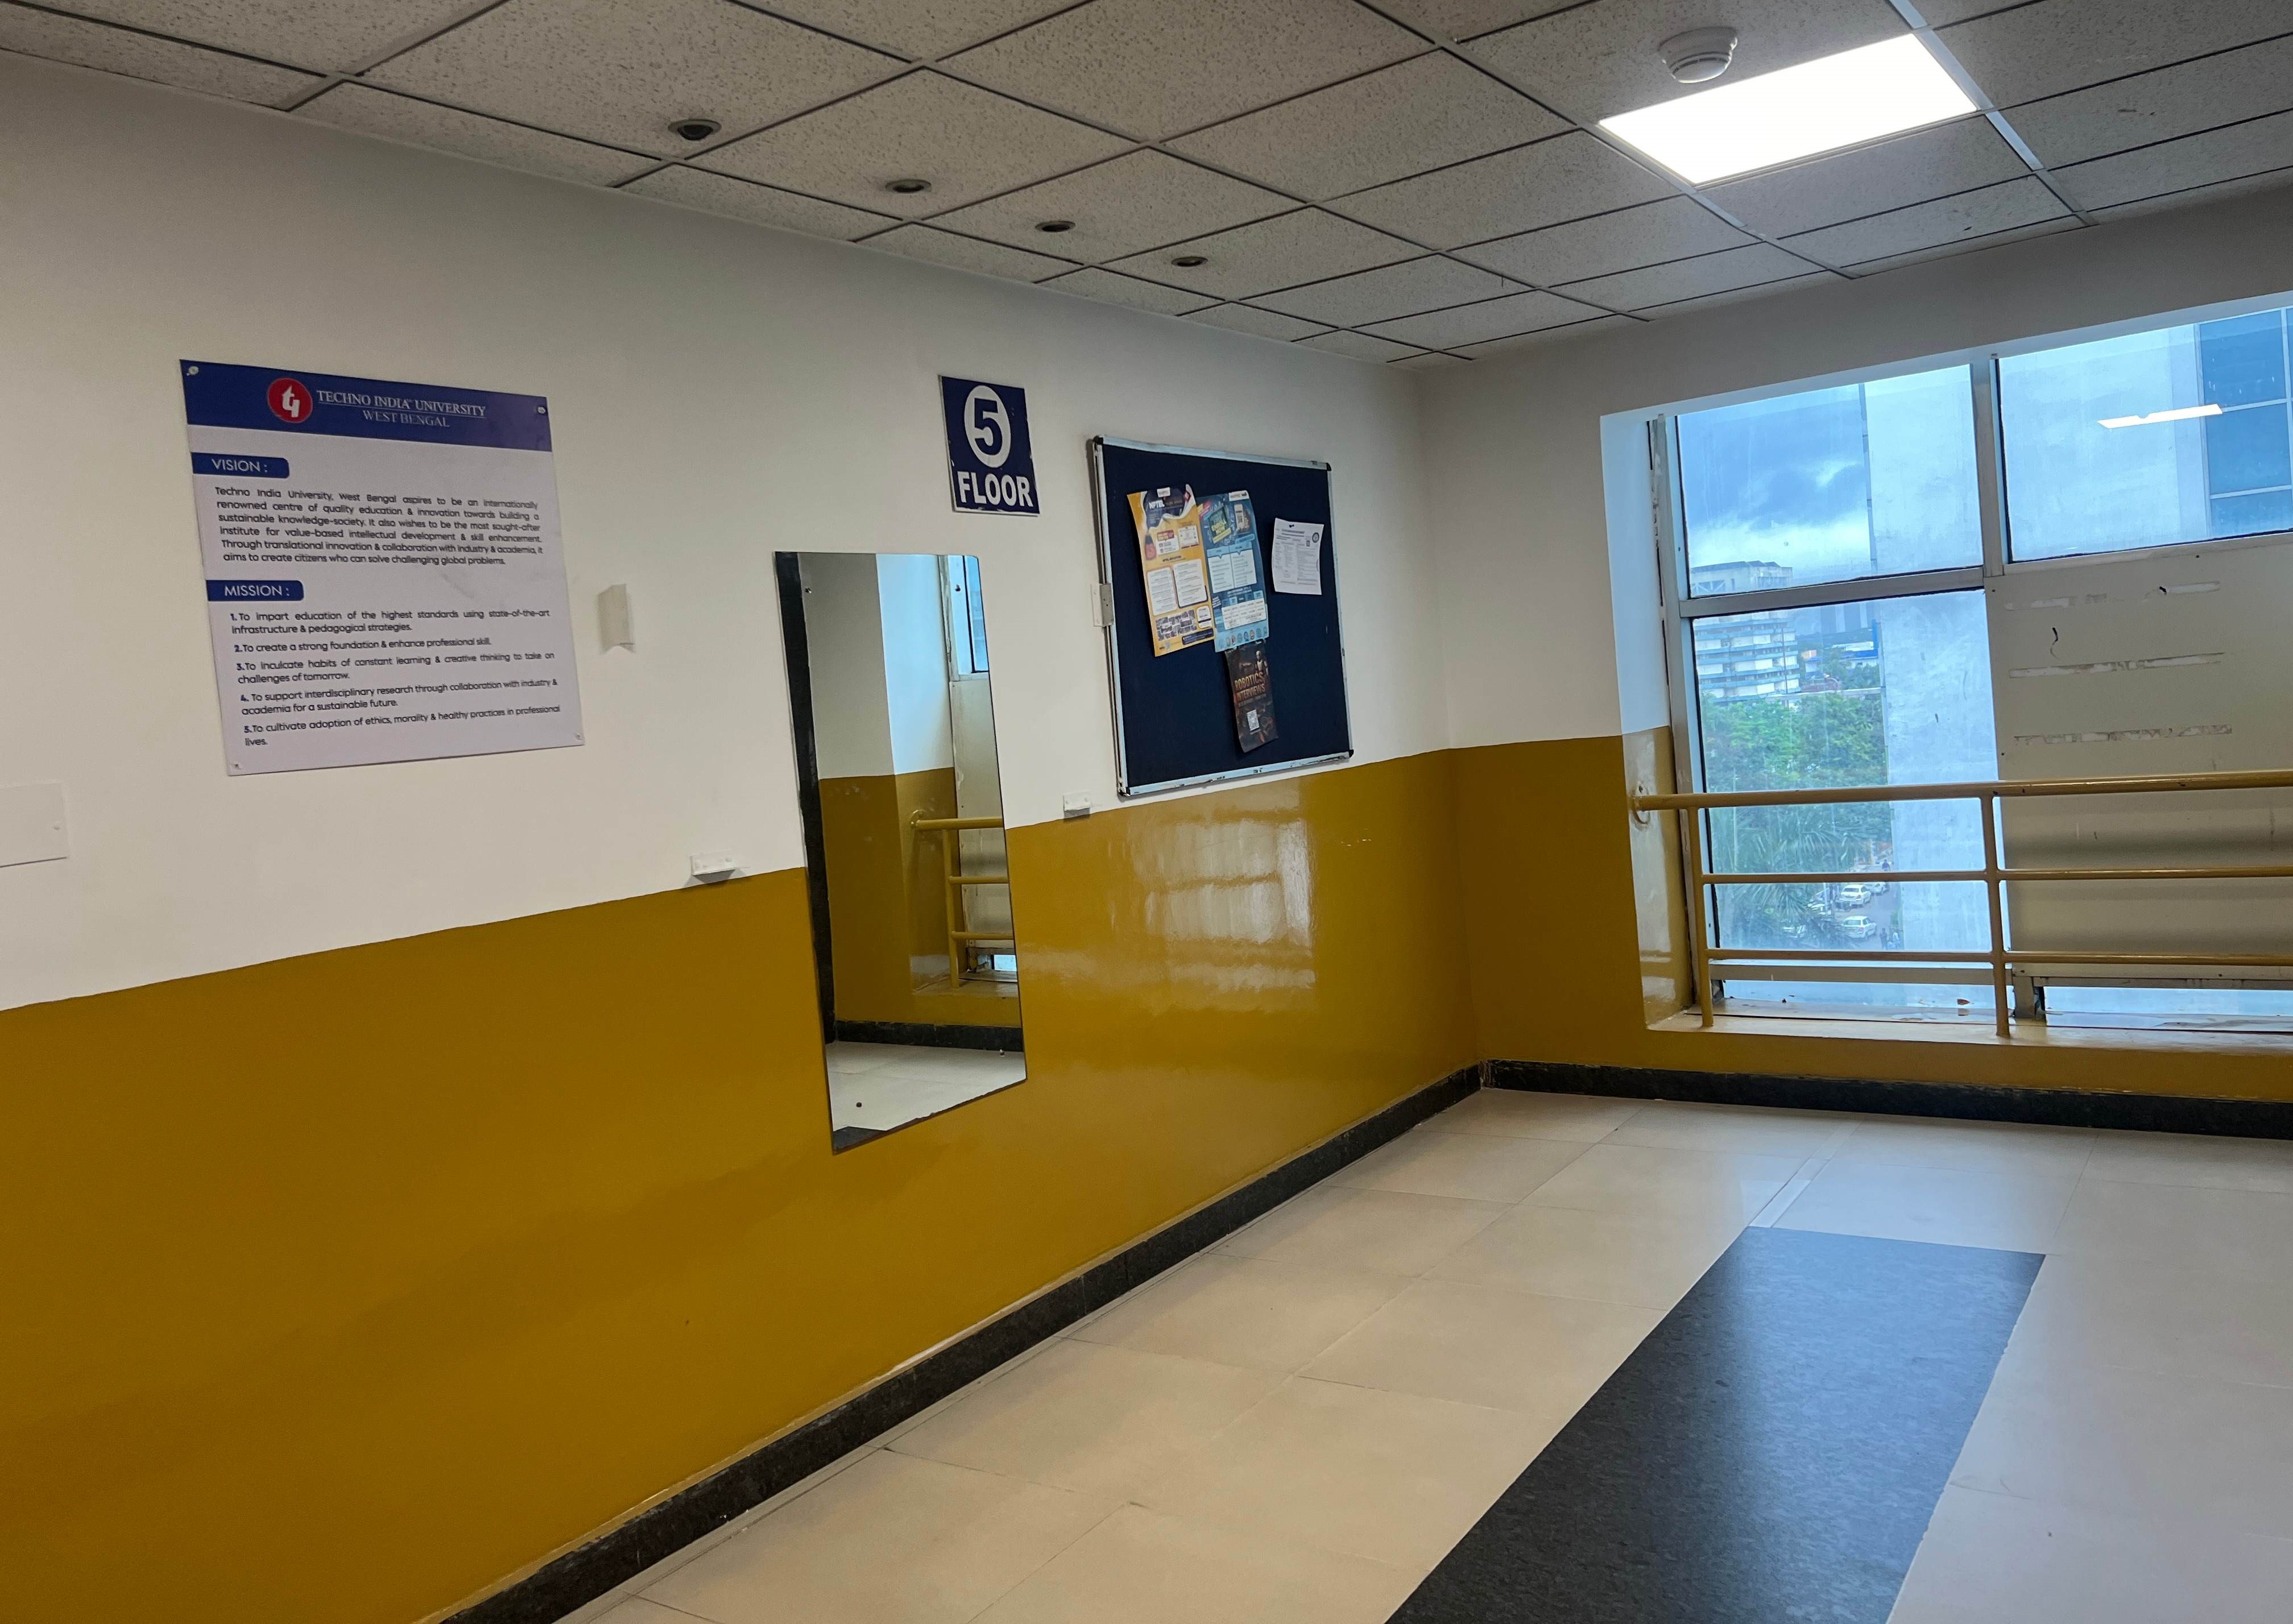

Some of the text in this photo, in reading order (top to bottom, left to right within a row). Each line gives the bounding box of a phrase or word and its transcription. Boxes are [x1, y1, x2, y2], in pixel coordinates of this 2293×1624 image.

[316, 390, 486, 416] TECHNO INDIA UNIVERSITY
[363, 410, 450, 427] WEST BENGAL
[974, 397, 1003, 456] 5
[211, 458, 261, 473] VISION
[214, 486, 251, 496] Techno
[256, 488, 282, 498] India
[338, 493, 361, 502] West
[366, 494, 397, 504] Bengal
[957, 470, 1034, 508] FLOOR
[216, 501, 267, 510] renowned
[308, 503, 318, 512] of
[322, 505, 354, 515] quality
[358, 506, 403, 515] education
[463, 510, 496, 519] towards
[499, 511, 530, 521] building
[218, 513, 275, 523] sustainable
[278, 515, 367, 528] knowledge-society.
[378, 519, 396, 527] also
[398, 519, 427, 528] wishes
[492, 523, 540, 532] sought-after
[266, 527, 280, 536] for
[284, 528, 344, 538] value-based
[349, 530, 396, 539] intellectual
[401, 531, 456, 541] development
[221, 539, 262, 550] Through
[264, 541, 324, 550] translational
[382, 543, 437, 552] collaboration
[223, 553, 247, 561] aims
[294, 554, 328, 562] citizens
[329, 554, 348, 562] who
[391, 555, 440, 566] challenging
[441, 556, 467, 566] global
[467, 556, 506, 565] problems.
[224, 585, 283, 597] MISSION
[295, 612, 342, 620] education
[347, 611, 357, 619] of
[361, 611, 376, 619] the
[381, 611, 413, 620] highest
[488, 609, 551, 618] state-of-the-art
[308, 623, 366, 634] pedagogical
[367, 624, 413, 633] strategies.
[255, 644, 288, 652] create
[298, 643, 328, 652] strong
[330, 641, 379, 649] foundation
[388, 640, 425, 648] enhance
[427, 638, 475, 648] professional
[308, 659, 337, 668] habits
[341, 658, 351, 667] of
[354, 658, 393, 666] constant
[396, 657, 431, 665] learning
[237, 674, 291, 684] challenges
[292, 672, 302, 681] of
[1234, 671, 1264, 692] ROBOTICS
[264, 692, 303, 701] support
[304, 688, 375, 698] interdisciplinary
[376, 685, 413, 695] research
[415, 684, 448, 693] through
[449, 682, 502, 691] collaboration
[1235, 683, 1266, 703] INTERVIEWS
[241, 705, 291, 715] academia
[292, 703, 307, 712] for
[317, 700, 368, 711] sustainable
[370, 699, 398, 707] future.
[265, 722, 307, 732] cultivate
[309, 720, 351, 729] adoption
[354, 717, 363, 726] of
[394, 714, 428, 723] morality
[438, 711, 469, 720] healthy
[470, 710, 506, 719] practices
[515, 706, 560, 716] professional
[245, 738, 268, 746] lives.
